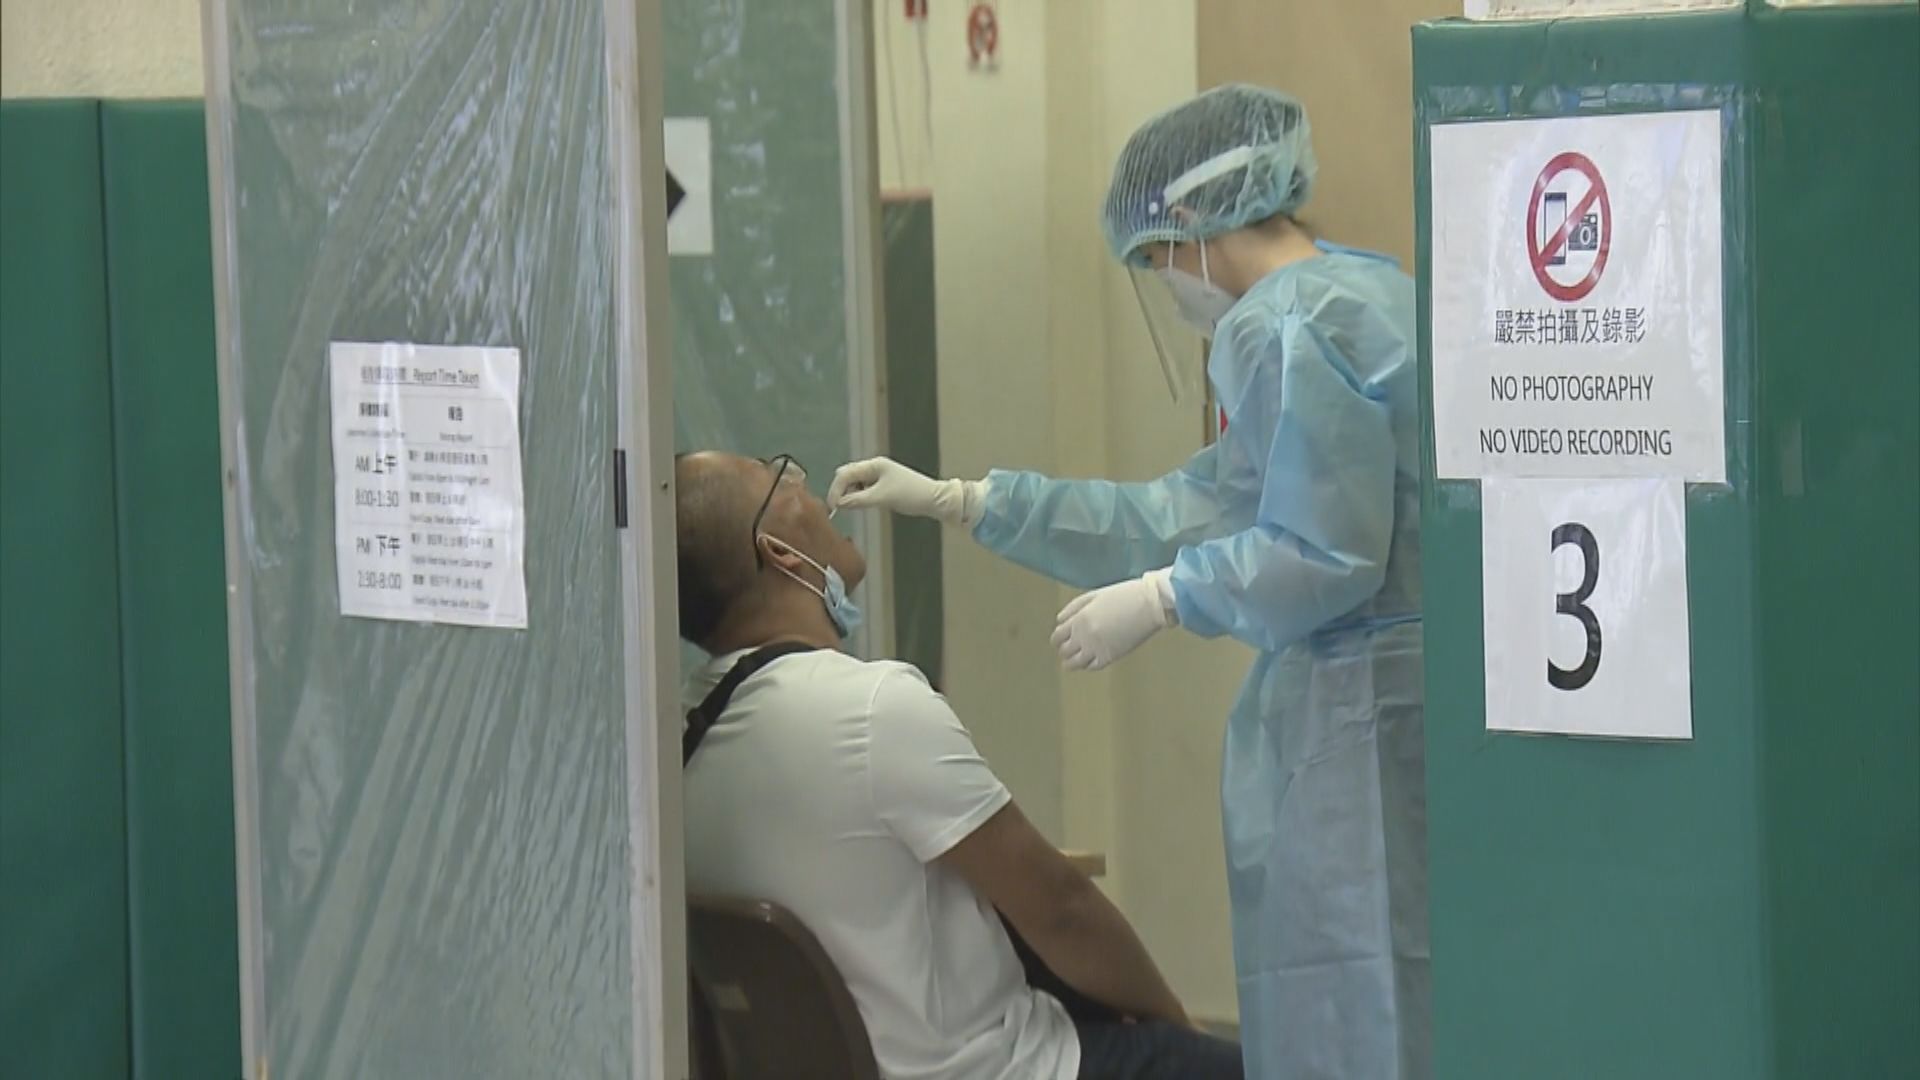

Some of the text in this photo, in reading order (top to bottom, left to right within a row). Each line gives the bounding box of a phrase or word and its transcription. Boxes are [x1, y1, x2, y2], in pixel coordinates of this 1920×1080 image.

[1494, 307, 1646, 344] 嚴禁拍攝及錄影
[1491, 375, 1654, 402] NO PHOTOGRAPHY
[1480, 428, 1672, 456] NO VIDEO RECORDING
[355, 455, 370, 473] AM
[372, 452, 398, 474] 上午
[356, 536, 371, 555] PM
[375, 534, 401, 557] 下午
[1547, 521, 1603, 692] 3
